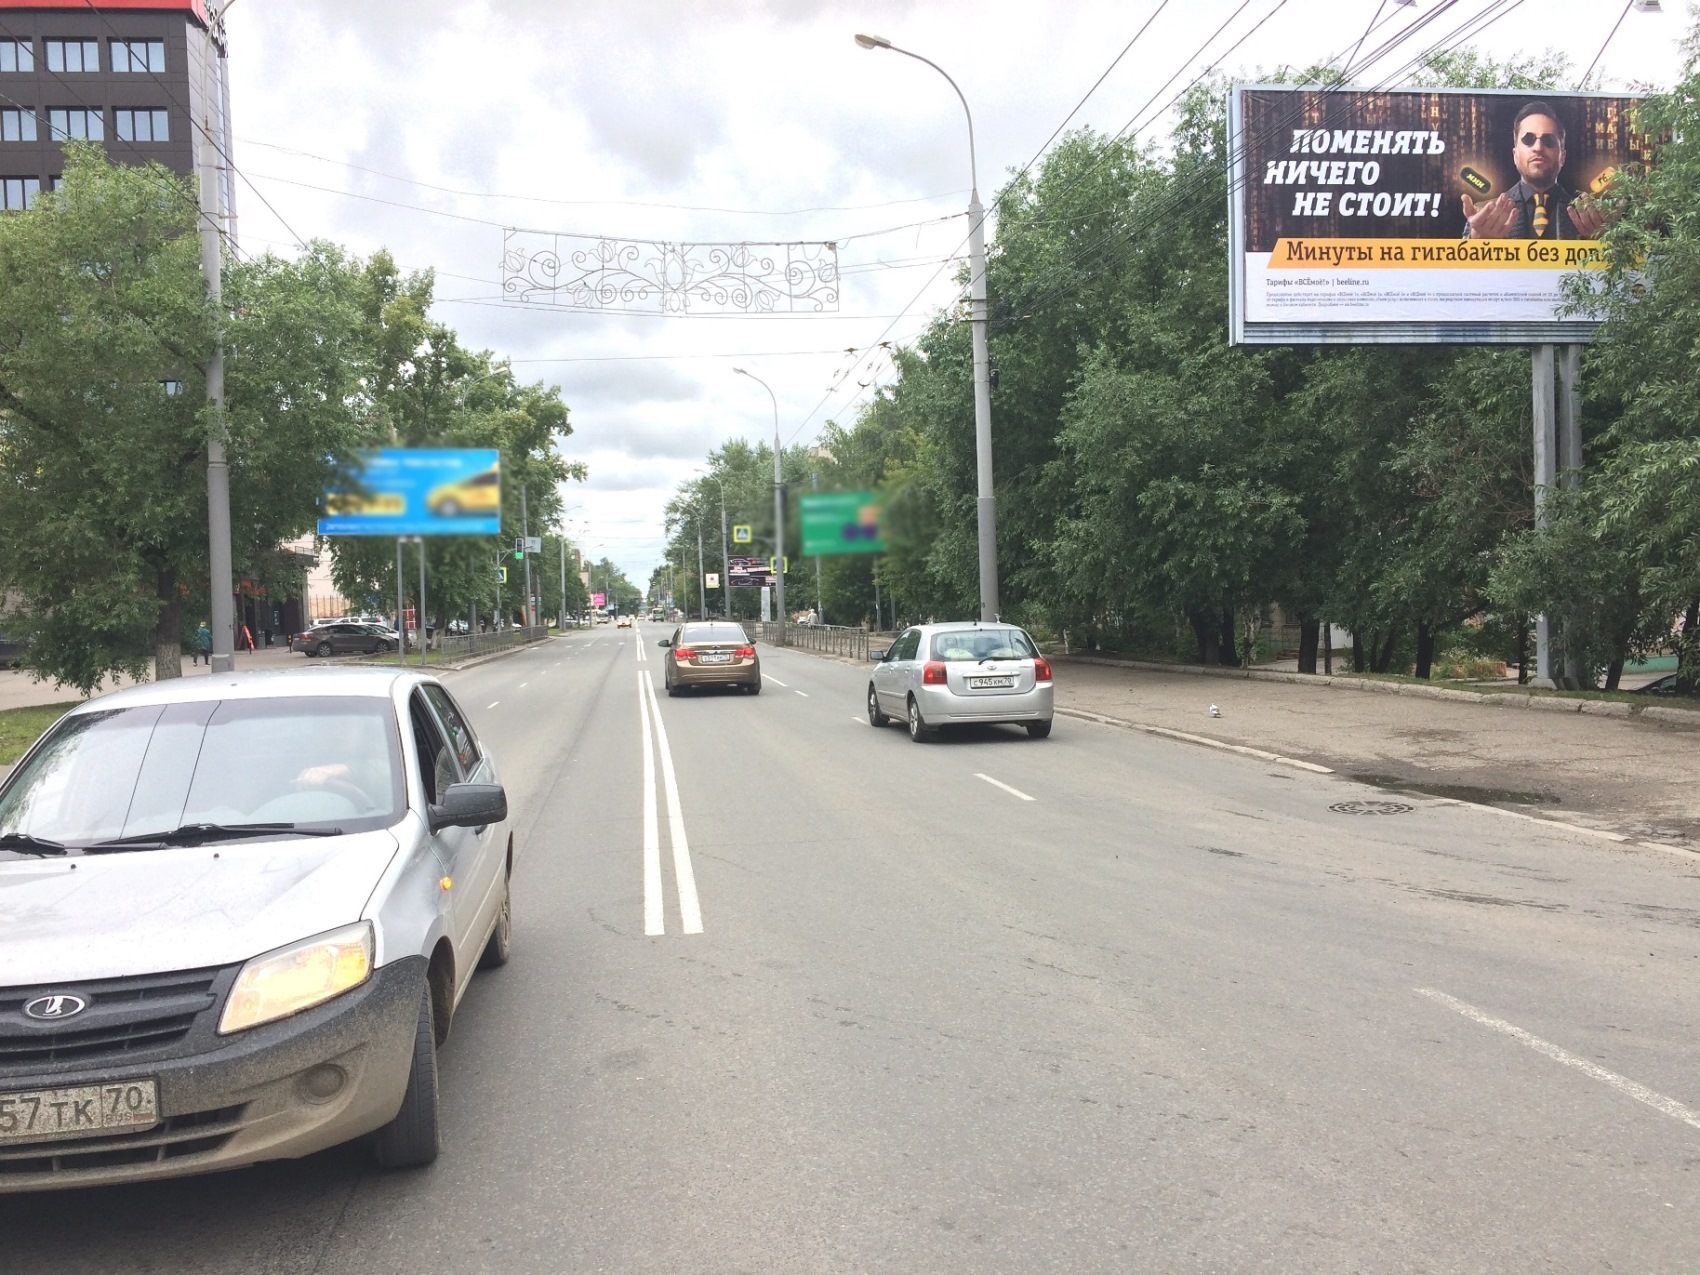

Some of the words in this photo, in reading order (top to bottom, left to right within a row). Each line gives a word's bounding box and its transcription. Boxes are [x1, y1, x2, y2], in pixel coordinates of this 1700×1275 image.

[1289, 129, 1446, 155] ПОМЕНЯТЬ
[1263, 160, 1381, 186] НИЧЕГО
[1291, 192, 1333, 216] НЕ
[1338, 192, 1442, 218] СТОИТ!
[1286, 241, 1374, 267] Минуты
[1379, 246, 1405, 261] на
[1411, 240, 1521, 262] гигабайты
[1526, 241, 1559, 262] без
[1265, 278, 1294, 288] Тарифы
[1336, 277, 1370, 287] beeline.ru
[105, 1085, 143, 1114] 70
